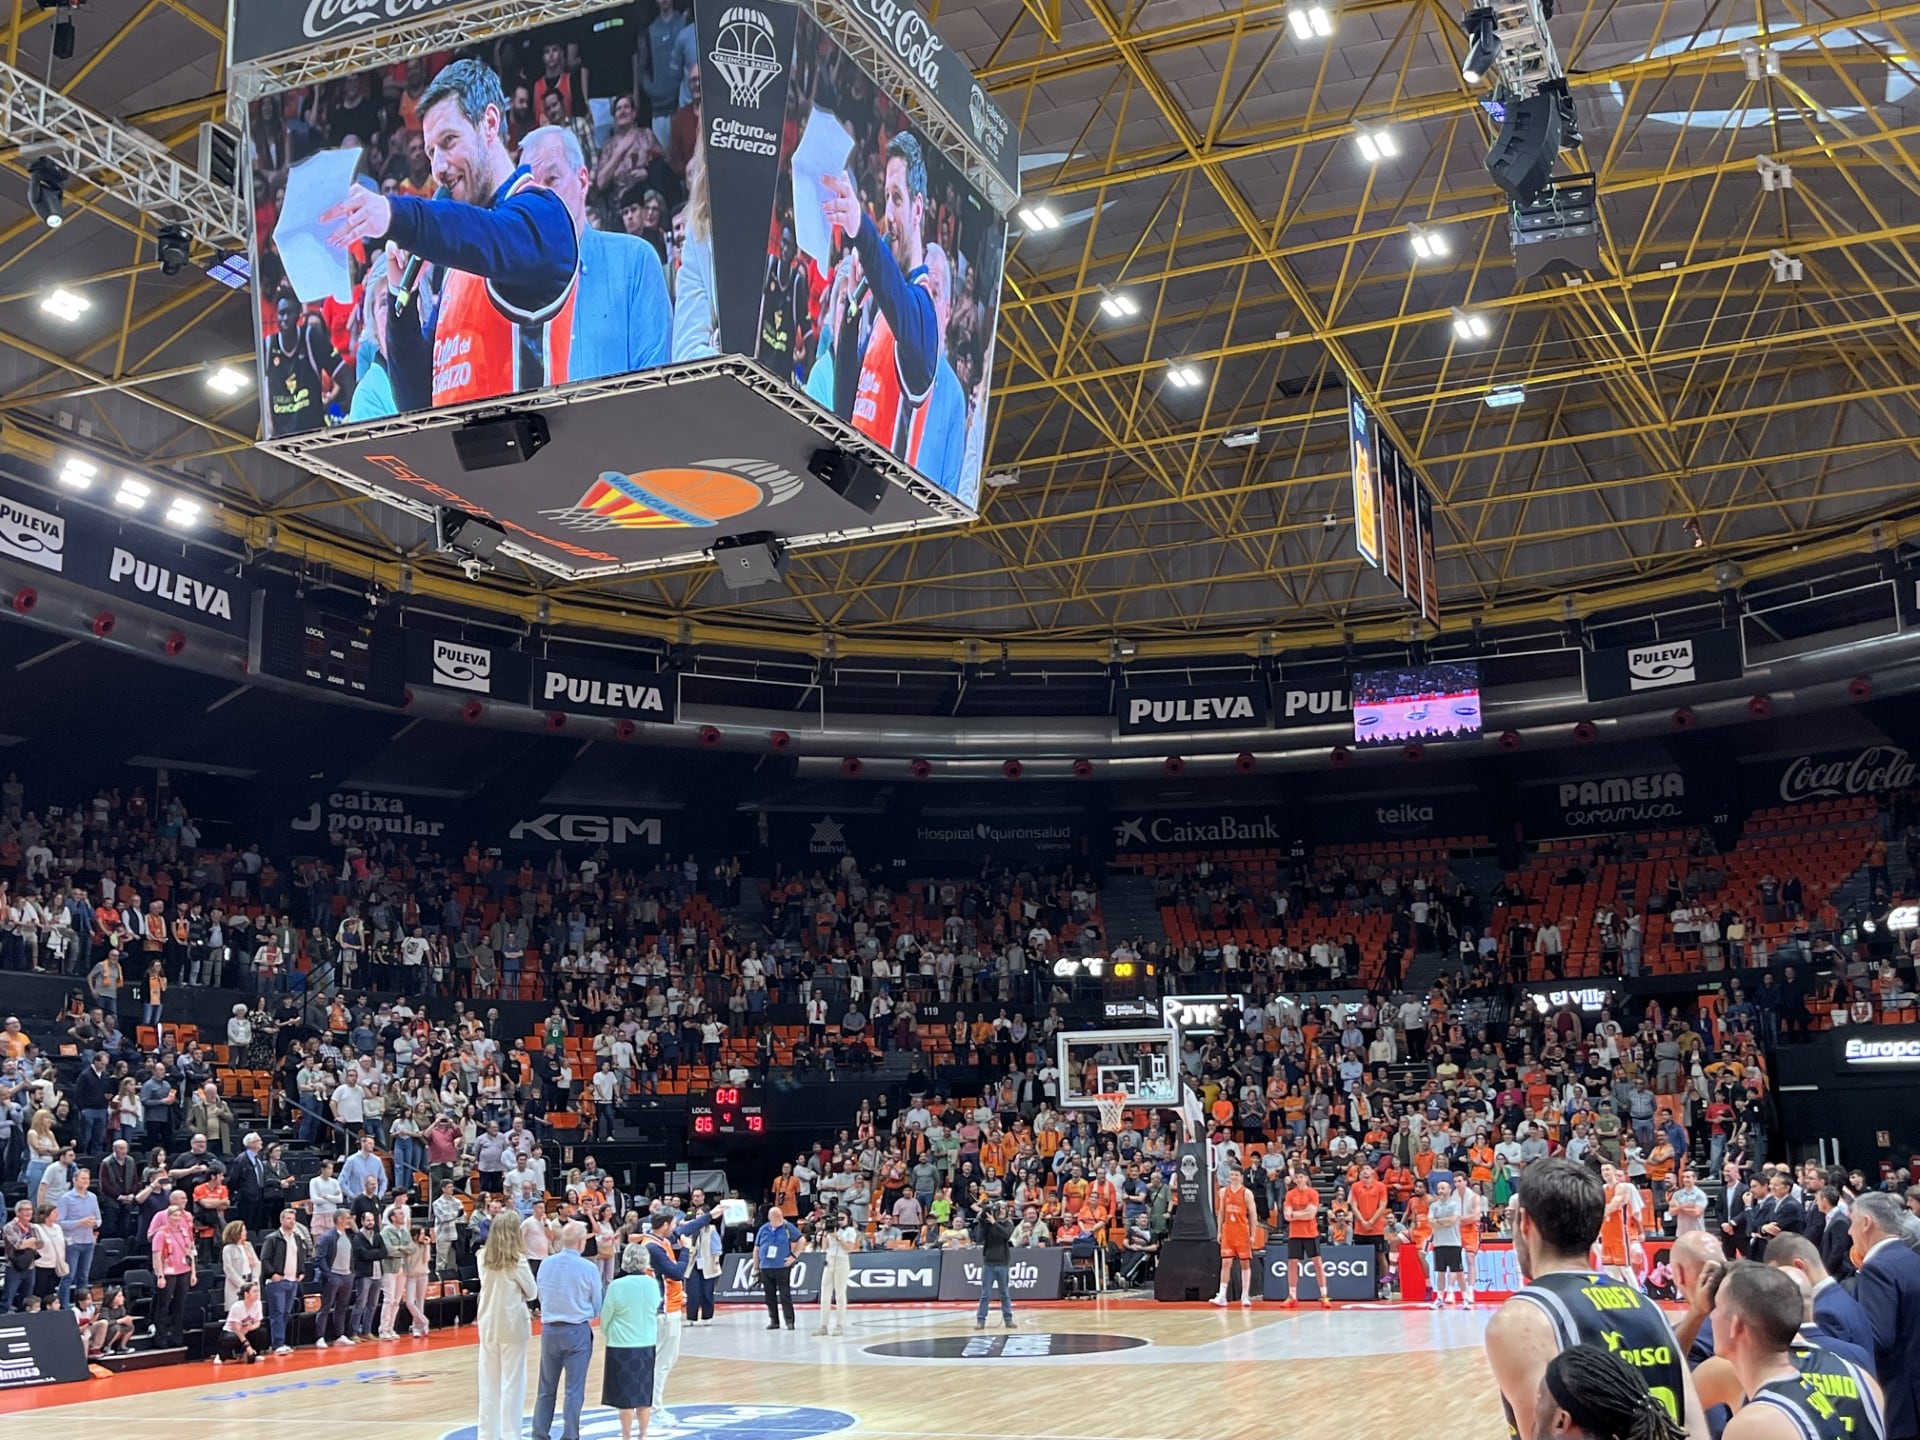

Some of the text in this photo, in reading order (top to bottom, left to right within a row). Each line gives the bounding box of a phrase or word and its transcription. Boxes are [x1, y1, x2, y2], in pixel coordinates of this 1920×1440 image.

[713, 53, 778, 72] VALENCIA BASKET
[712, 117, 777, 142] Cultura del
[709, 132, 777, 156] Esfuerzo
[609, 476, 668, 511] VALENCIA
[0, 503, 60, 539] PULEVA
[109, 546, 232, 621] PULEVA
[305, 626, 326, 640] LOCAL
[437, 645, 487, 667] PULEVA
[1632, 646, 1689, 667] PULEVA
[543, 671, 664, 711] PULEVA
[1129, 696, 1255, 725] PULEVA
[1285, 690, 1353, 717] PUL
[1780, 745, 1917, 802] Coca-Cola
[328, 791, 404, 813] caixa
[1559, 773, 1684, 807] PAMESA
[328, 813, 445, 837] popular
[1375, 803, 1434, 824] teika
[1713, 814, 1729, 824] 217
[510, 814, 662, 844] KGM
[917, 827, 974, 843] Hospital
[1150, 815, 1281, 843] CaixaBank
[487, 847, 502, 856] 20
[923, 1006, 939, 1016] 119
[1180, 1004, 1217, 1026] JYS
[691, 1106, 713, 1114] LOCAL
[1580, 1282, 1641, 1311] TOBEY
